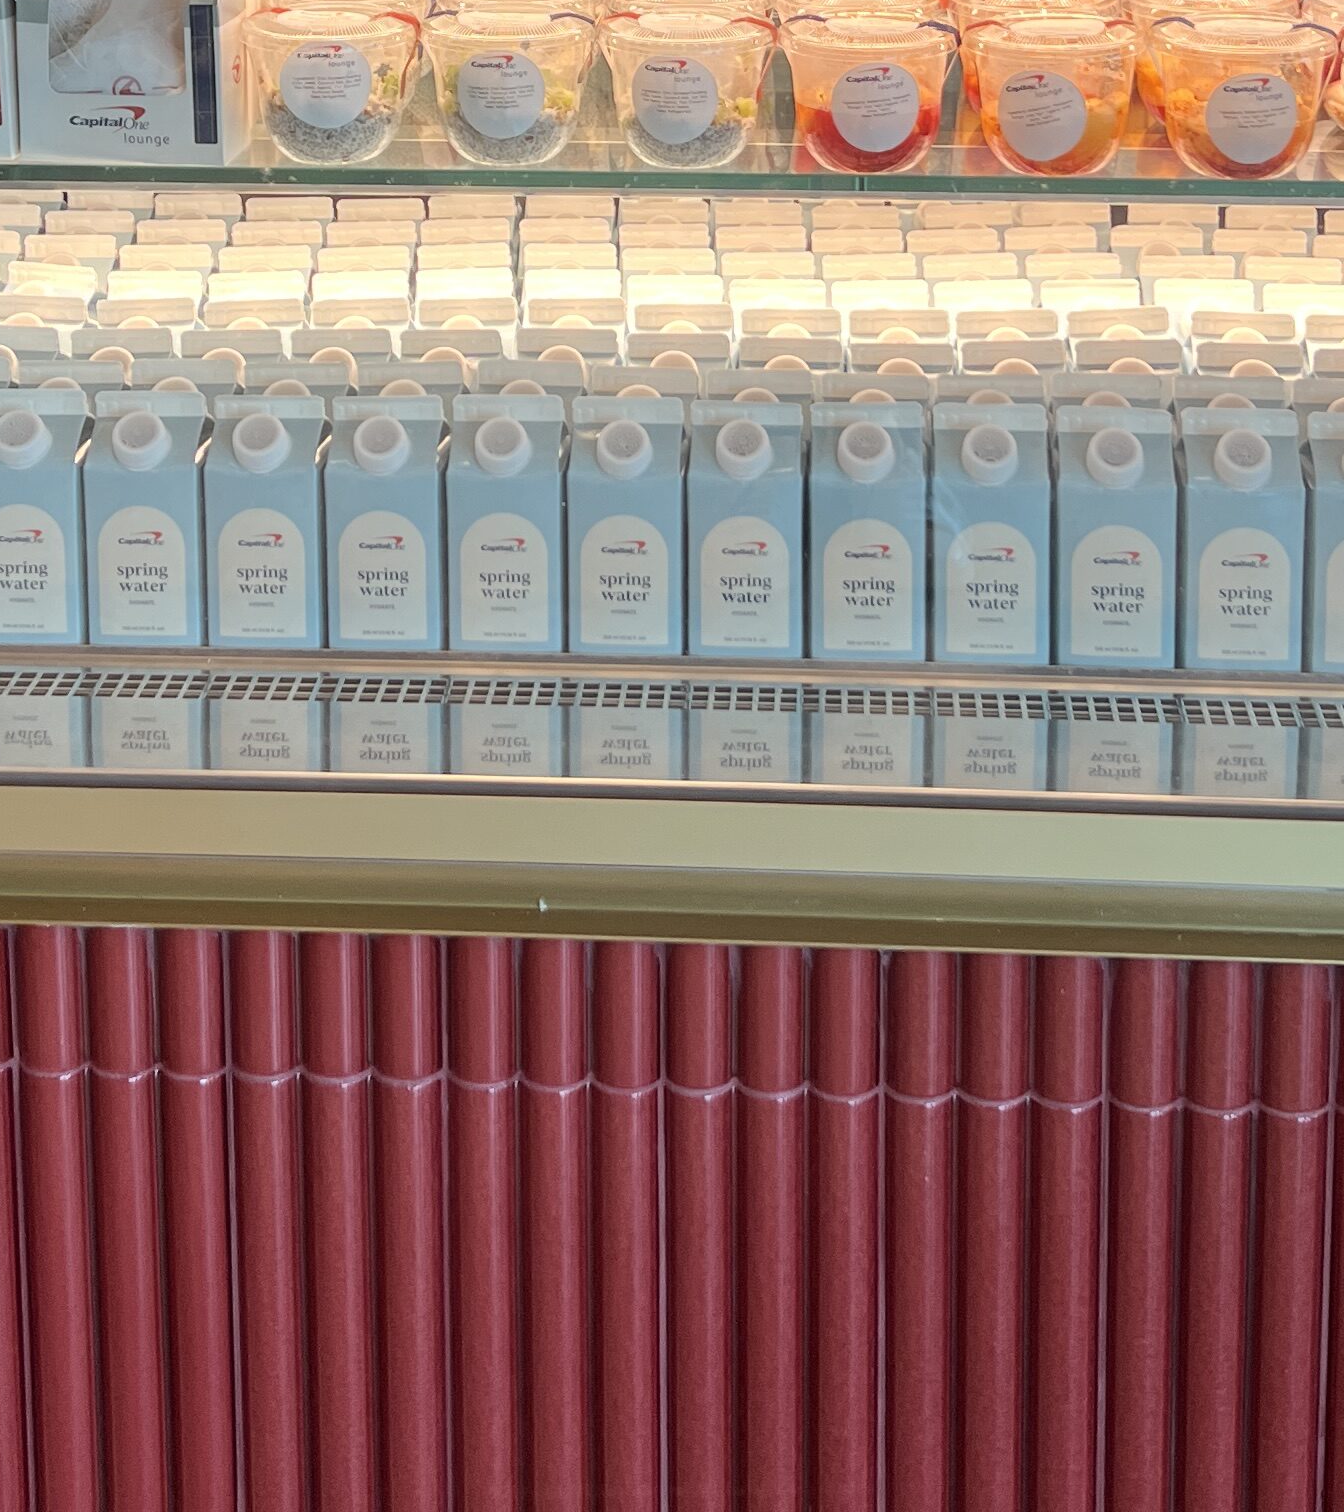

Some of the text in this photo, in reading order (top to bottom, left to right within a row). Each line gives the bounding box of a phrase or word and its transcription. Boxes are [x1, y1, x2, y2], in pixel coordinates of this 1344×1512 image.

[124, 132, 170, 148] lounge
[116, 562, 168, 581] spring
[119, 578, 167, 593] water
[719, 573, 773, 591] spring
[722, 589, 770, 604] water
